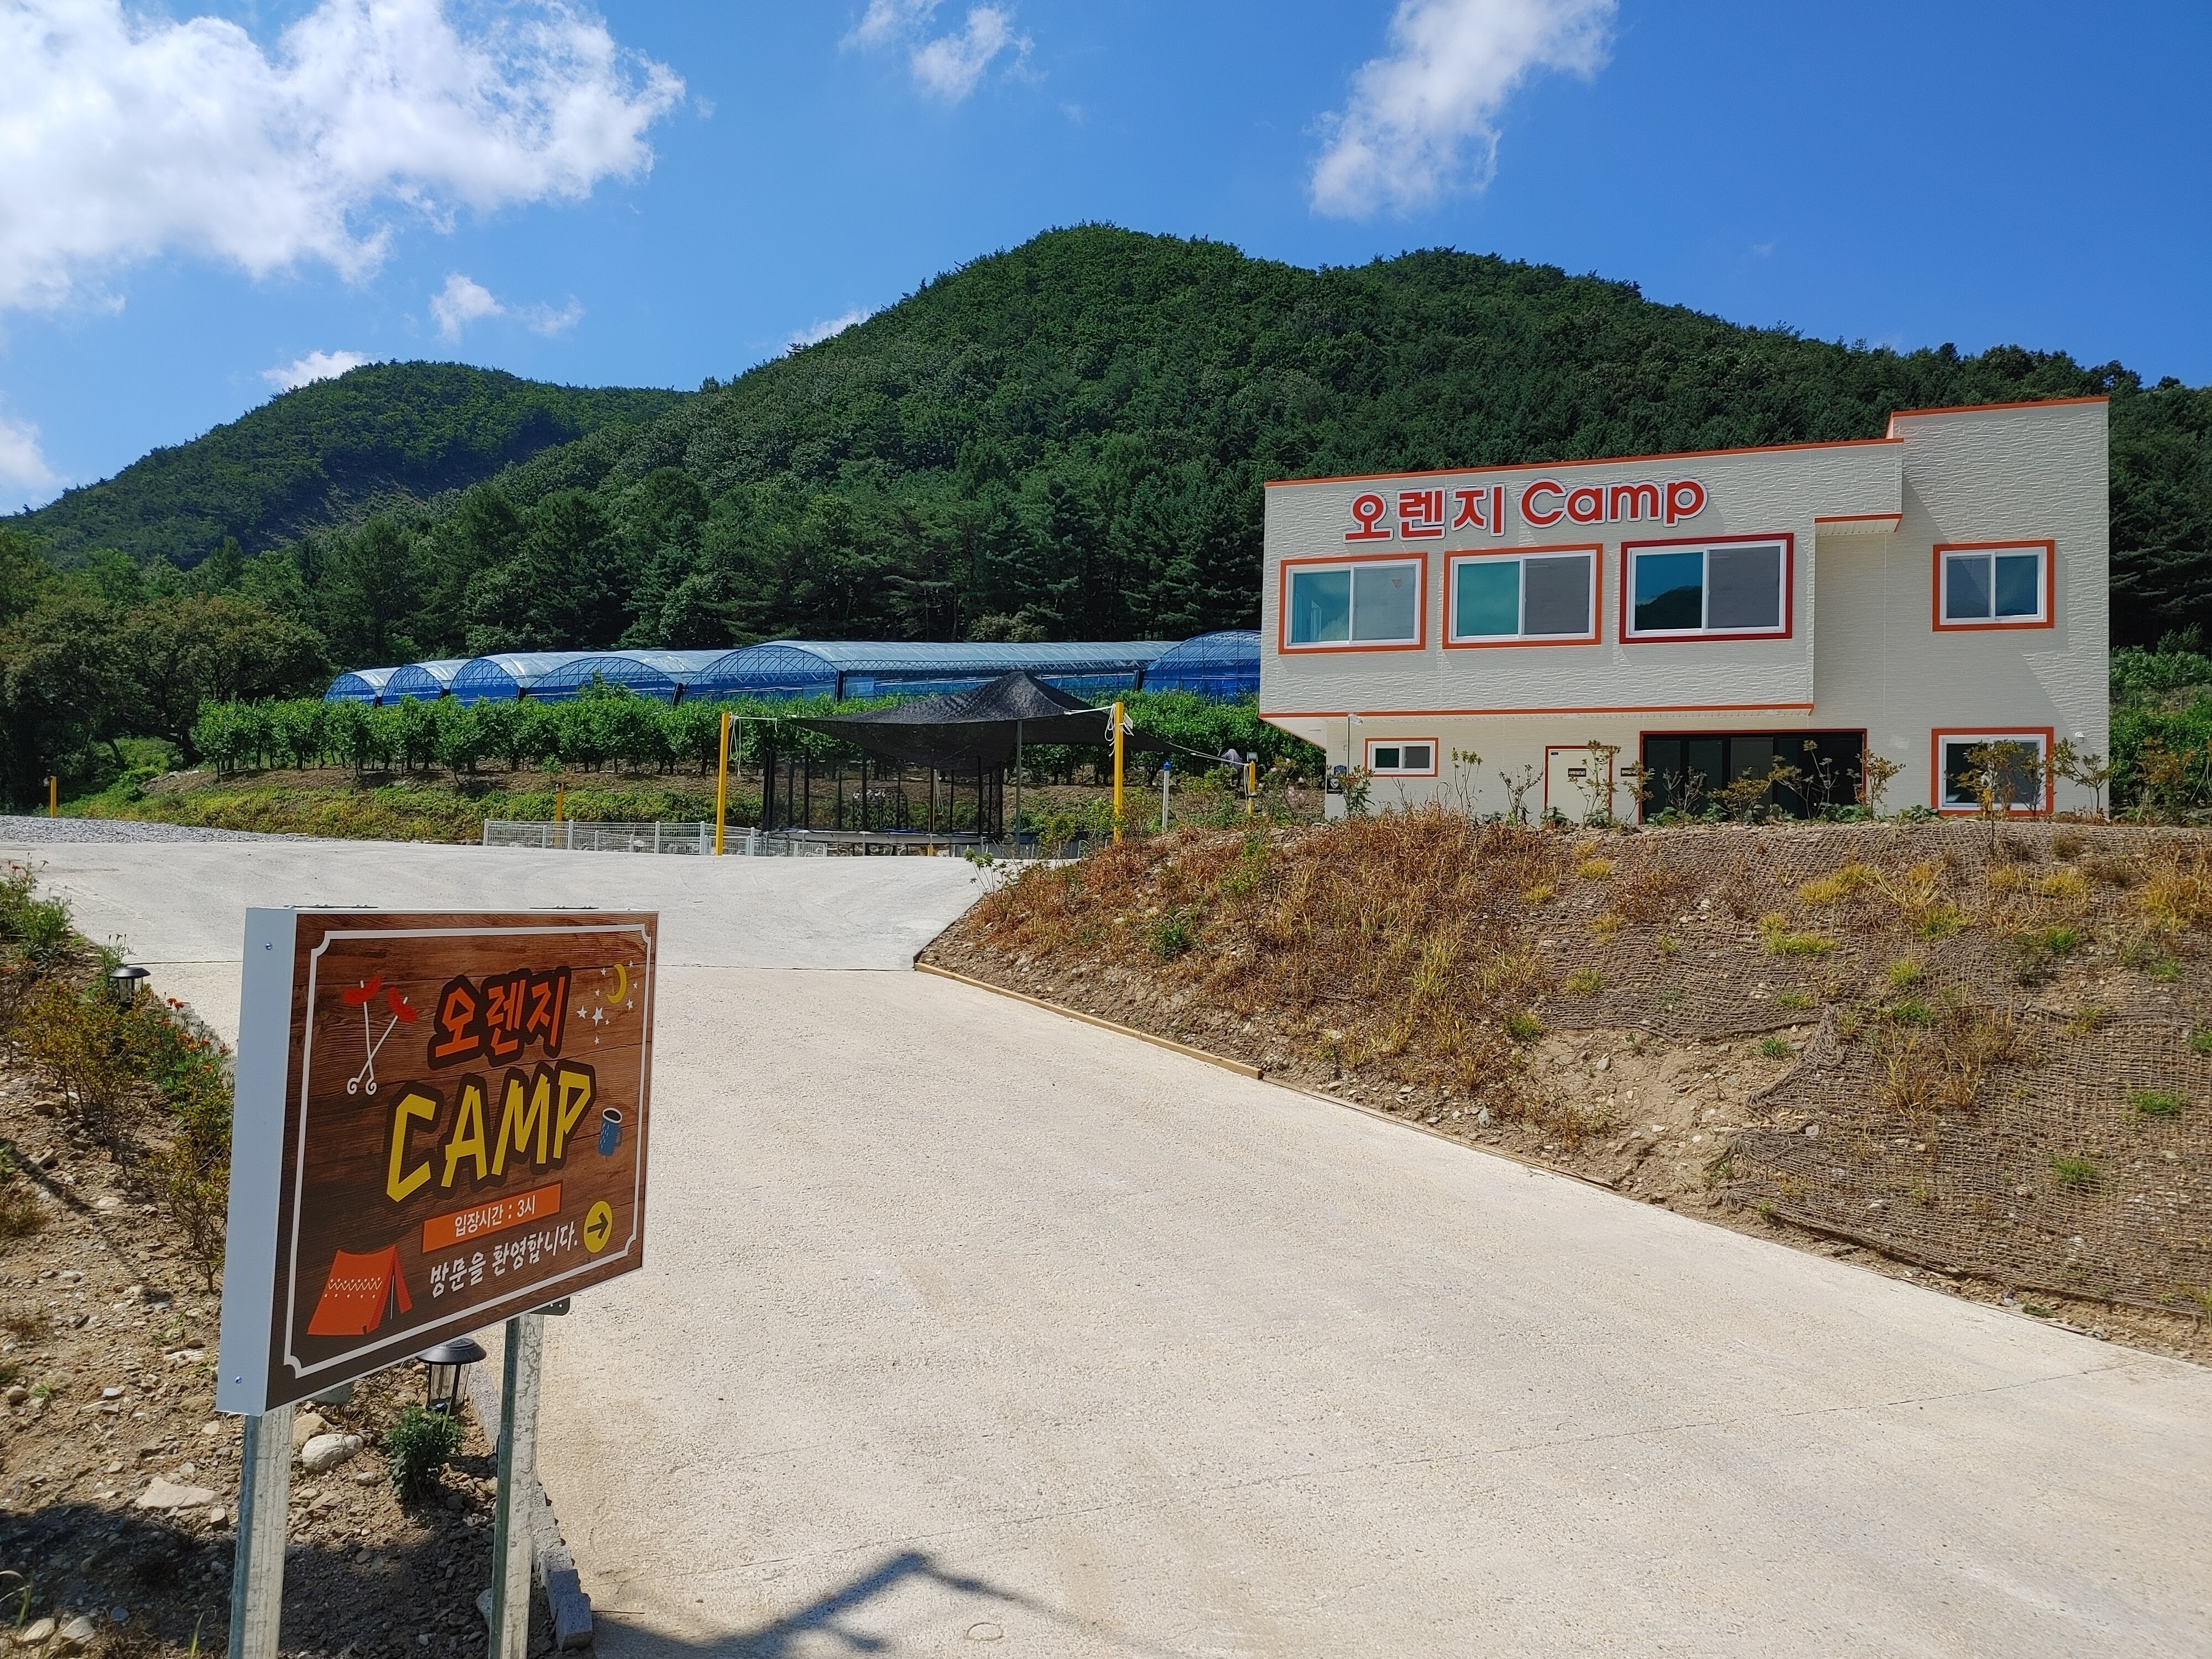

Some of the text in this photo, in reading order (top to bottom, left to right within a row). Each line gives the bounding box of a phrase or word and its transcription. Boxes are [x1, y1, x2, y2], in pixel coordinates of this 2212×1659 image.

[1343, 478, 1709, 543] 오렌지 Camp
[435, 976, 566, 1058] 오렌지
[387, 1070, 591, 1203] CAMP
[455, 1203, 504, 1238] 입장시간
[517, 1194, 536, 1218] 3시
[430, 1220, 578, 1299] 방문을 환영합니다.
